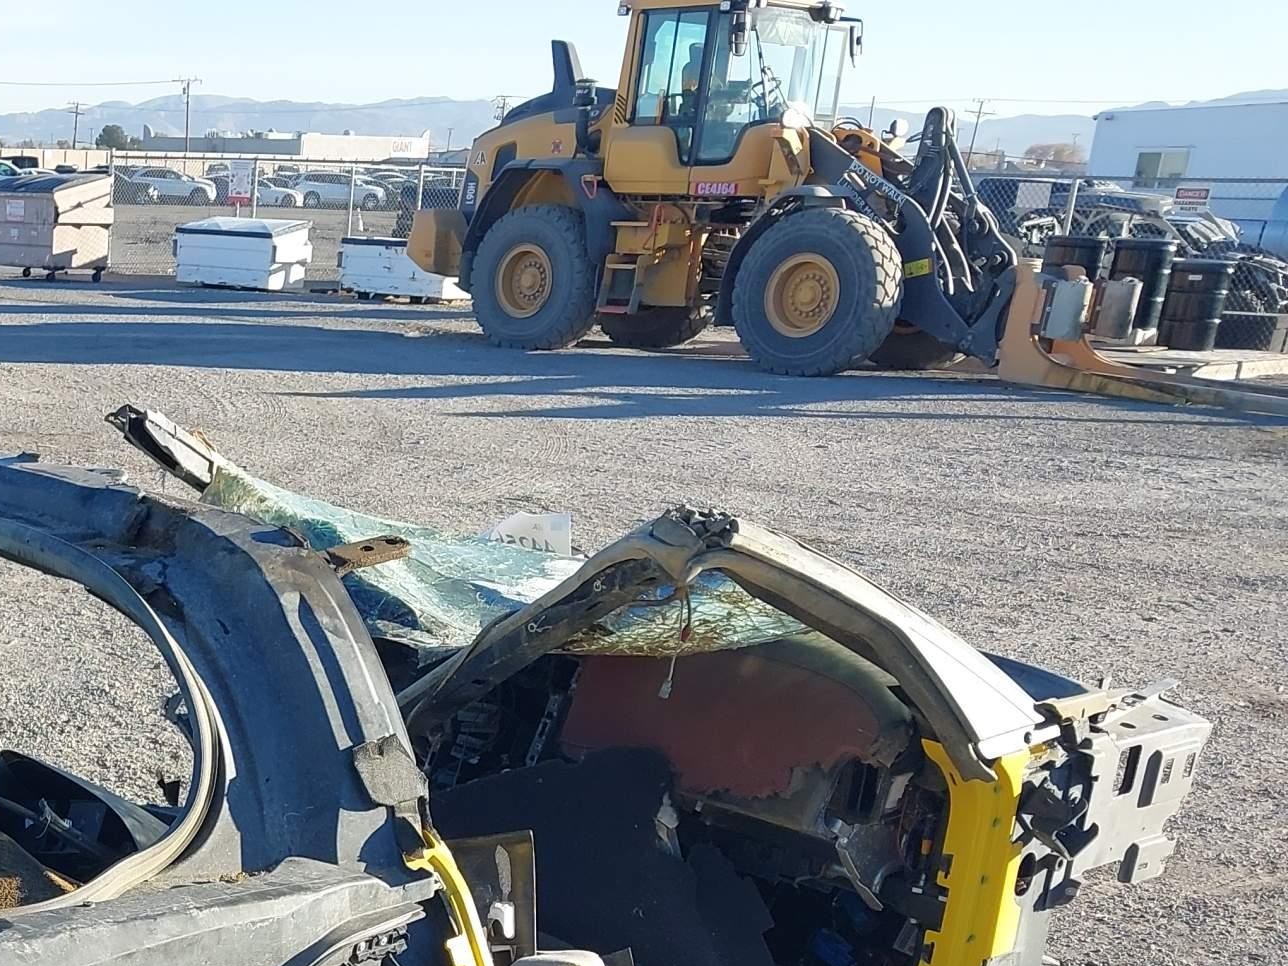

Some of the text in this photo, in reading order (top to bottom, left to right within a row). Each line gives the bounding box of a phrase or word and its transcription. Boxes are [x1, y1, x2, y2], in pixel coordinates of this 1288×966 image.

[465, 182, 477, 205] L90H
[851, 161, 904, 204] DO NOT WALK
